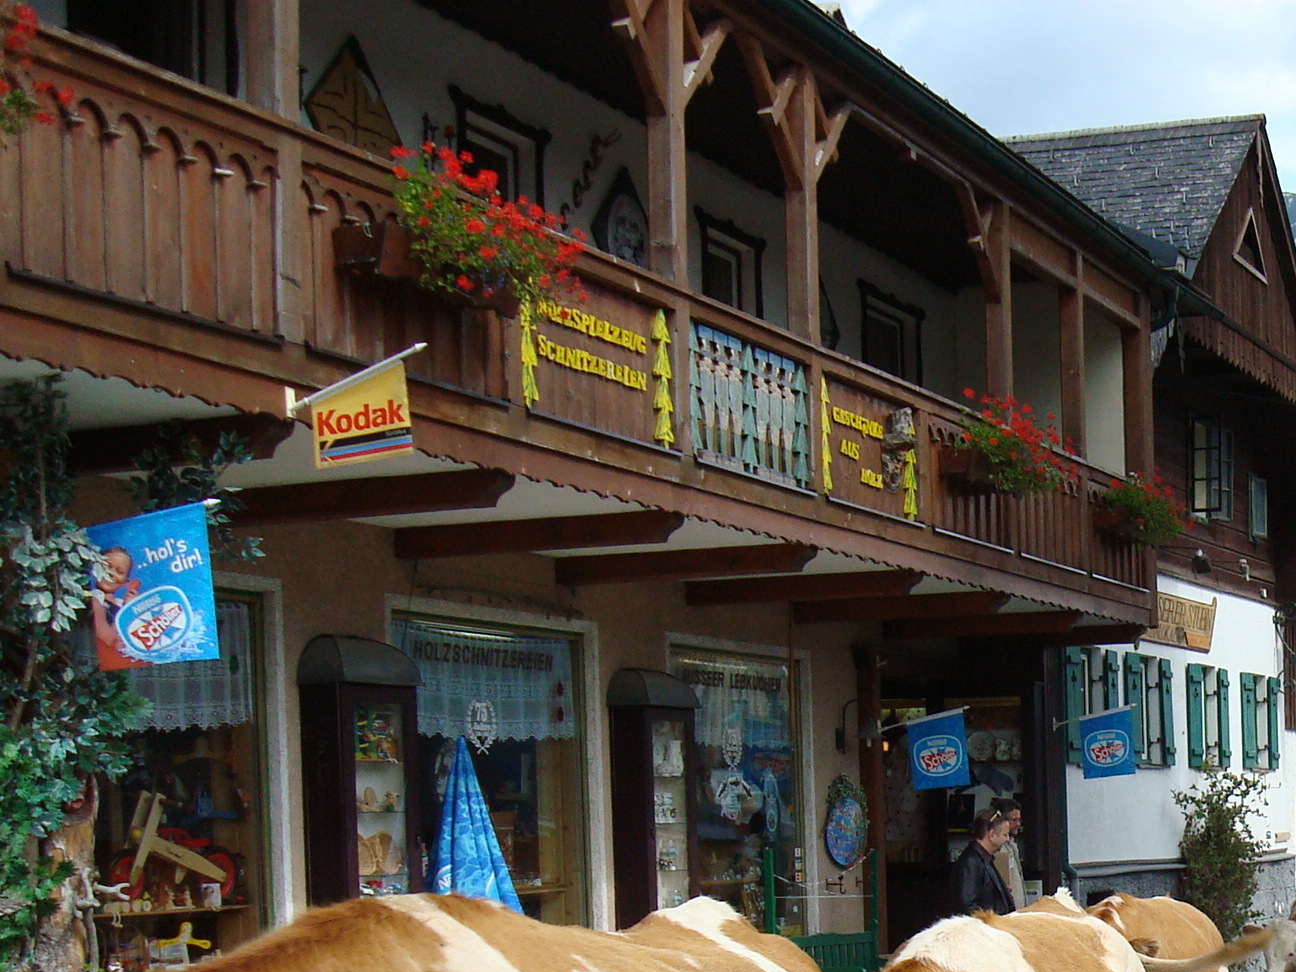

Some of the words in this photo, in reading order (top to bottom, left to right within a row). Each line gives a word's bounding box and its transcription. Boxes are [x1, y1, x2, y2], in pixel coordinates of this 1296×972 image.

[537, 334, 648, 391] SCHNITZEREIEN
[317, 399, 405, 437] Kodak
[841, 439, 860, 461] AUS
[170, 547, 204, 574] dir!
[412, 639, 554, 673] HOLZSCHNITZEREIEN
